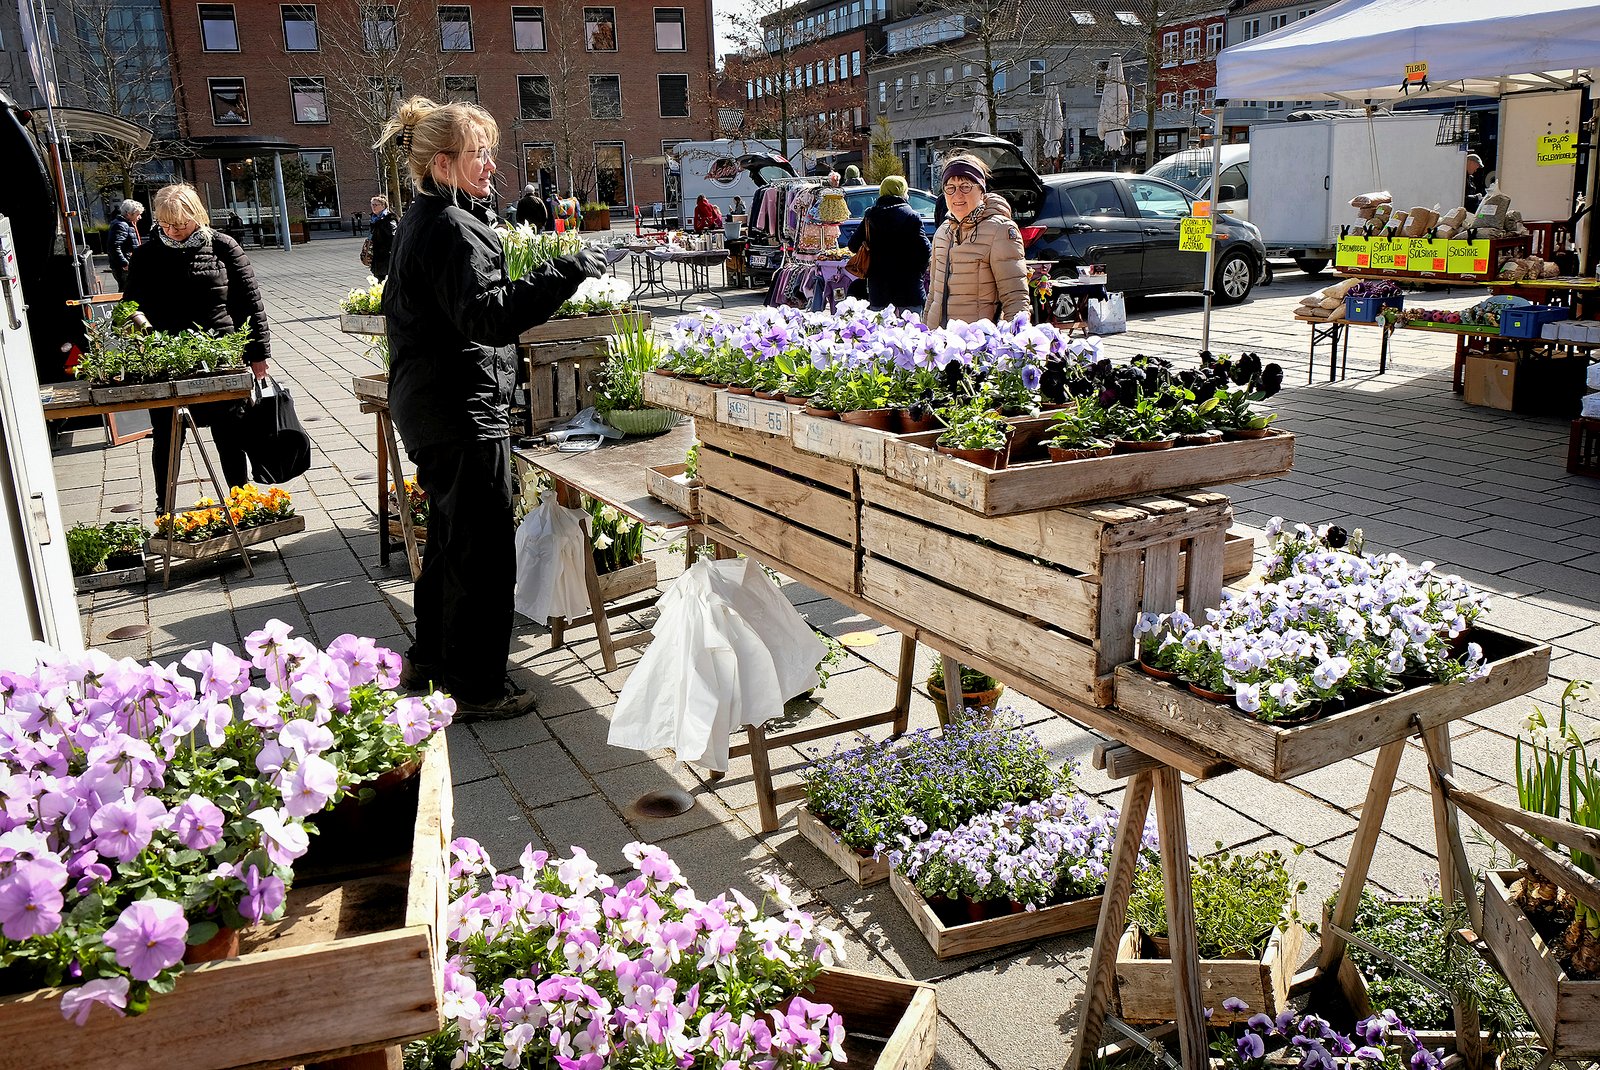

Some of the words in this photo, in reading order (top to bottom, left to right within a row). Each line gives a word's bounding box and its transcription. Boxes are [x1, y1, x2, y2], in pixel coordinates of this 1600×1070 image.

[1405, 63, 1427, 73] TILBUD
[1182, 242, 1204, 250] AFSTAND
[1408, 248, 1438, 259] SOLSIKKE
[1448, 246, 1478, 258] SOLSIKKE
[226, 378, 238, 388] 55
[768, 411, 782, 431] 55
